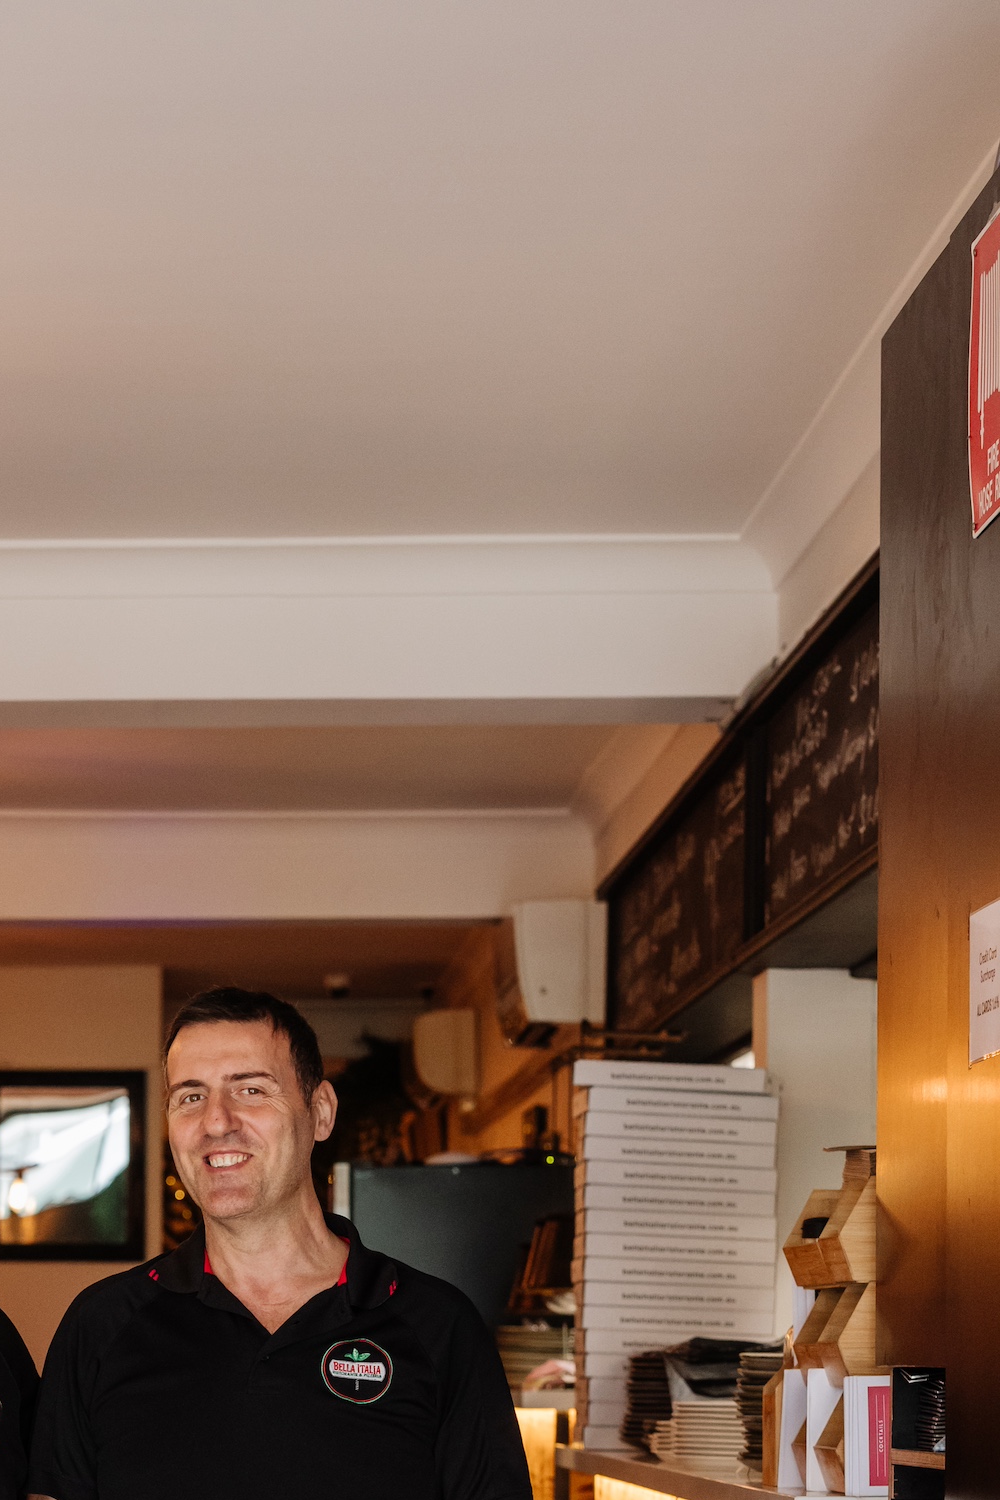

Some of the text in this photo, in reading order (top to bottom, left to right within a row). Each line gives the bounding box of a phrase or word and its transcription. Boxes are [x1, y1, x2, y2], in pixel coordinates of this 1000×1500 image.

[987, 438, 1000, 476] FIRE
[978, 479, 993, 519] HOSE
[333, 1361, 381, 1375] BELLA ITALIA
